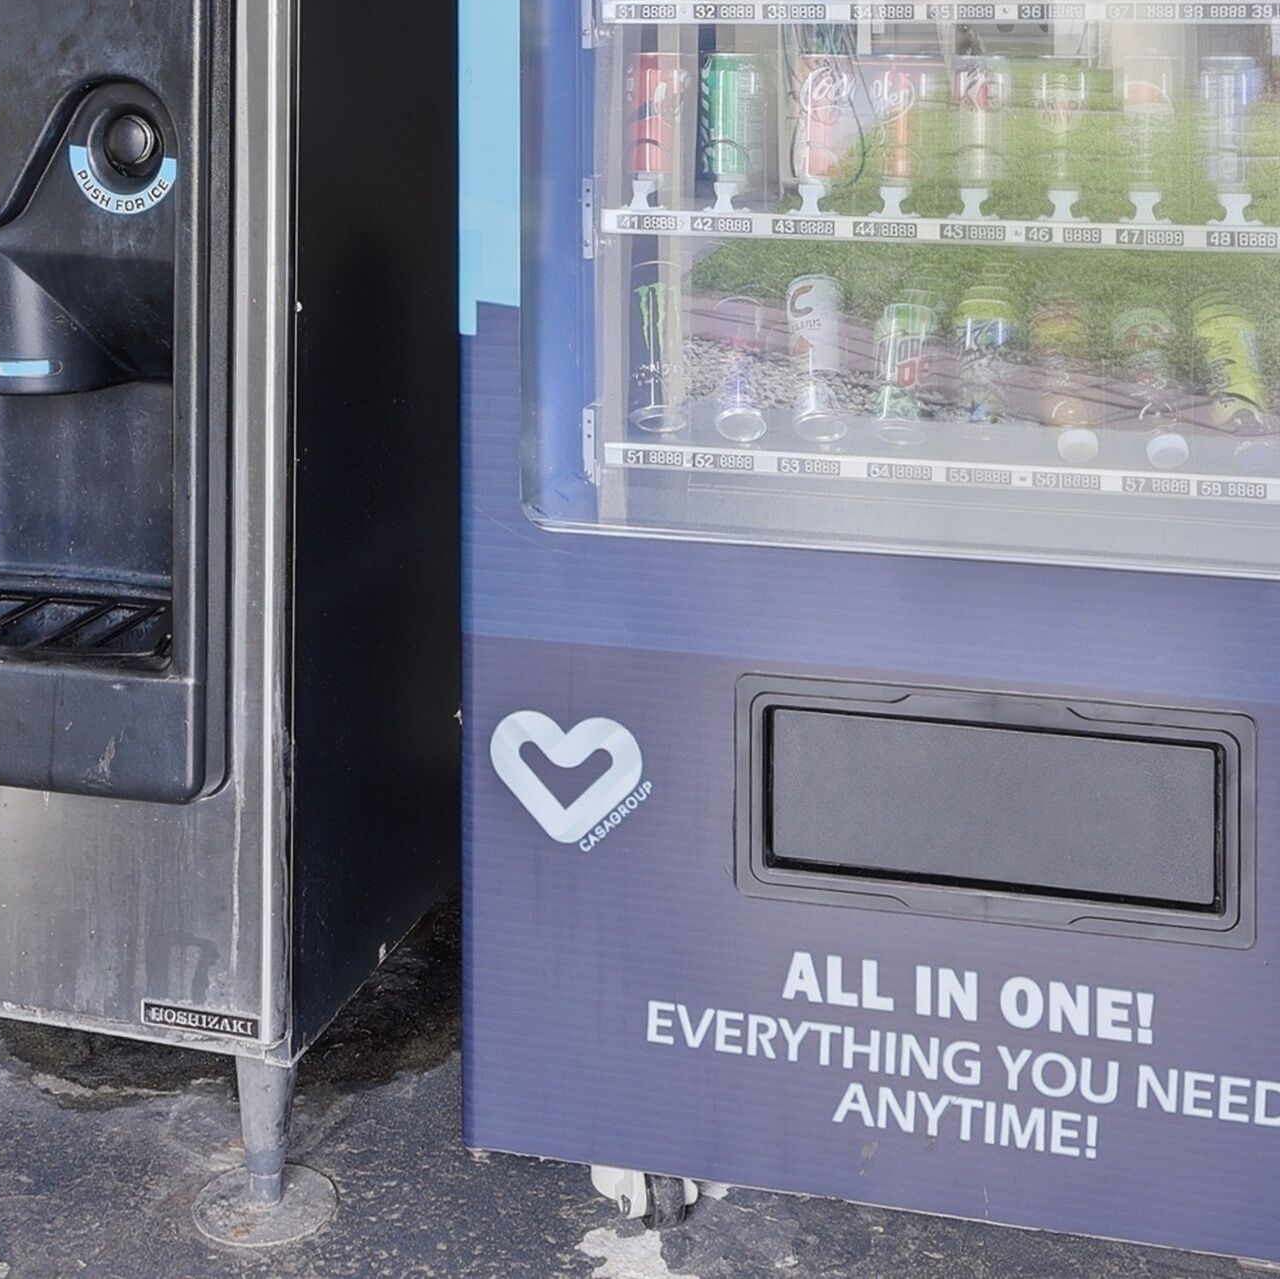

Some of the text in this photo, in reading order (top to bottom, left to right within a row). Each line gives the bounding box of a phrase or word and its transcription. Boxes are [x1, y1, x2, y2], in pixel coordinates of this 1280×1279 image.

[619, 6, 636, 17] 31
[696, 6, 715, 17] 32
[1021, 6, 1041, 17] 36
[1253, 5, 1273, 18] 39
[76, 169, 169, 210] PUSH FOR ICE
[621, 217, 637, 229] 41
[693, 218, 712, 231] 42
[775, 221, 794, 234] 43
[855, 223, 875, 235] 44
[1028, 227, 1049, 240] 46
[1120, 230, 1140, 243] 47
[1210, 233, 1231, 245] 48
[627, 451, 644, 464] 51
[695, 455, 714, 468] 52
[1125, 478, 1145, 491] 57
[578, 780, 653, 853] CASAGROUP
[782, 951, 1155, 1045] ALL IN ONE!
[150, 1006, 254, 1036] HOSHIZAKI
[646, 1000, 982, 1087] EVERYTHING
[997, 1045, 1119, 1104] YOU
[832, 1082, 1098, 1159] ANYTIME!
